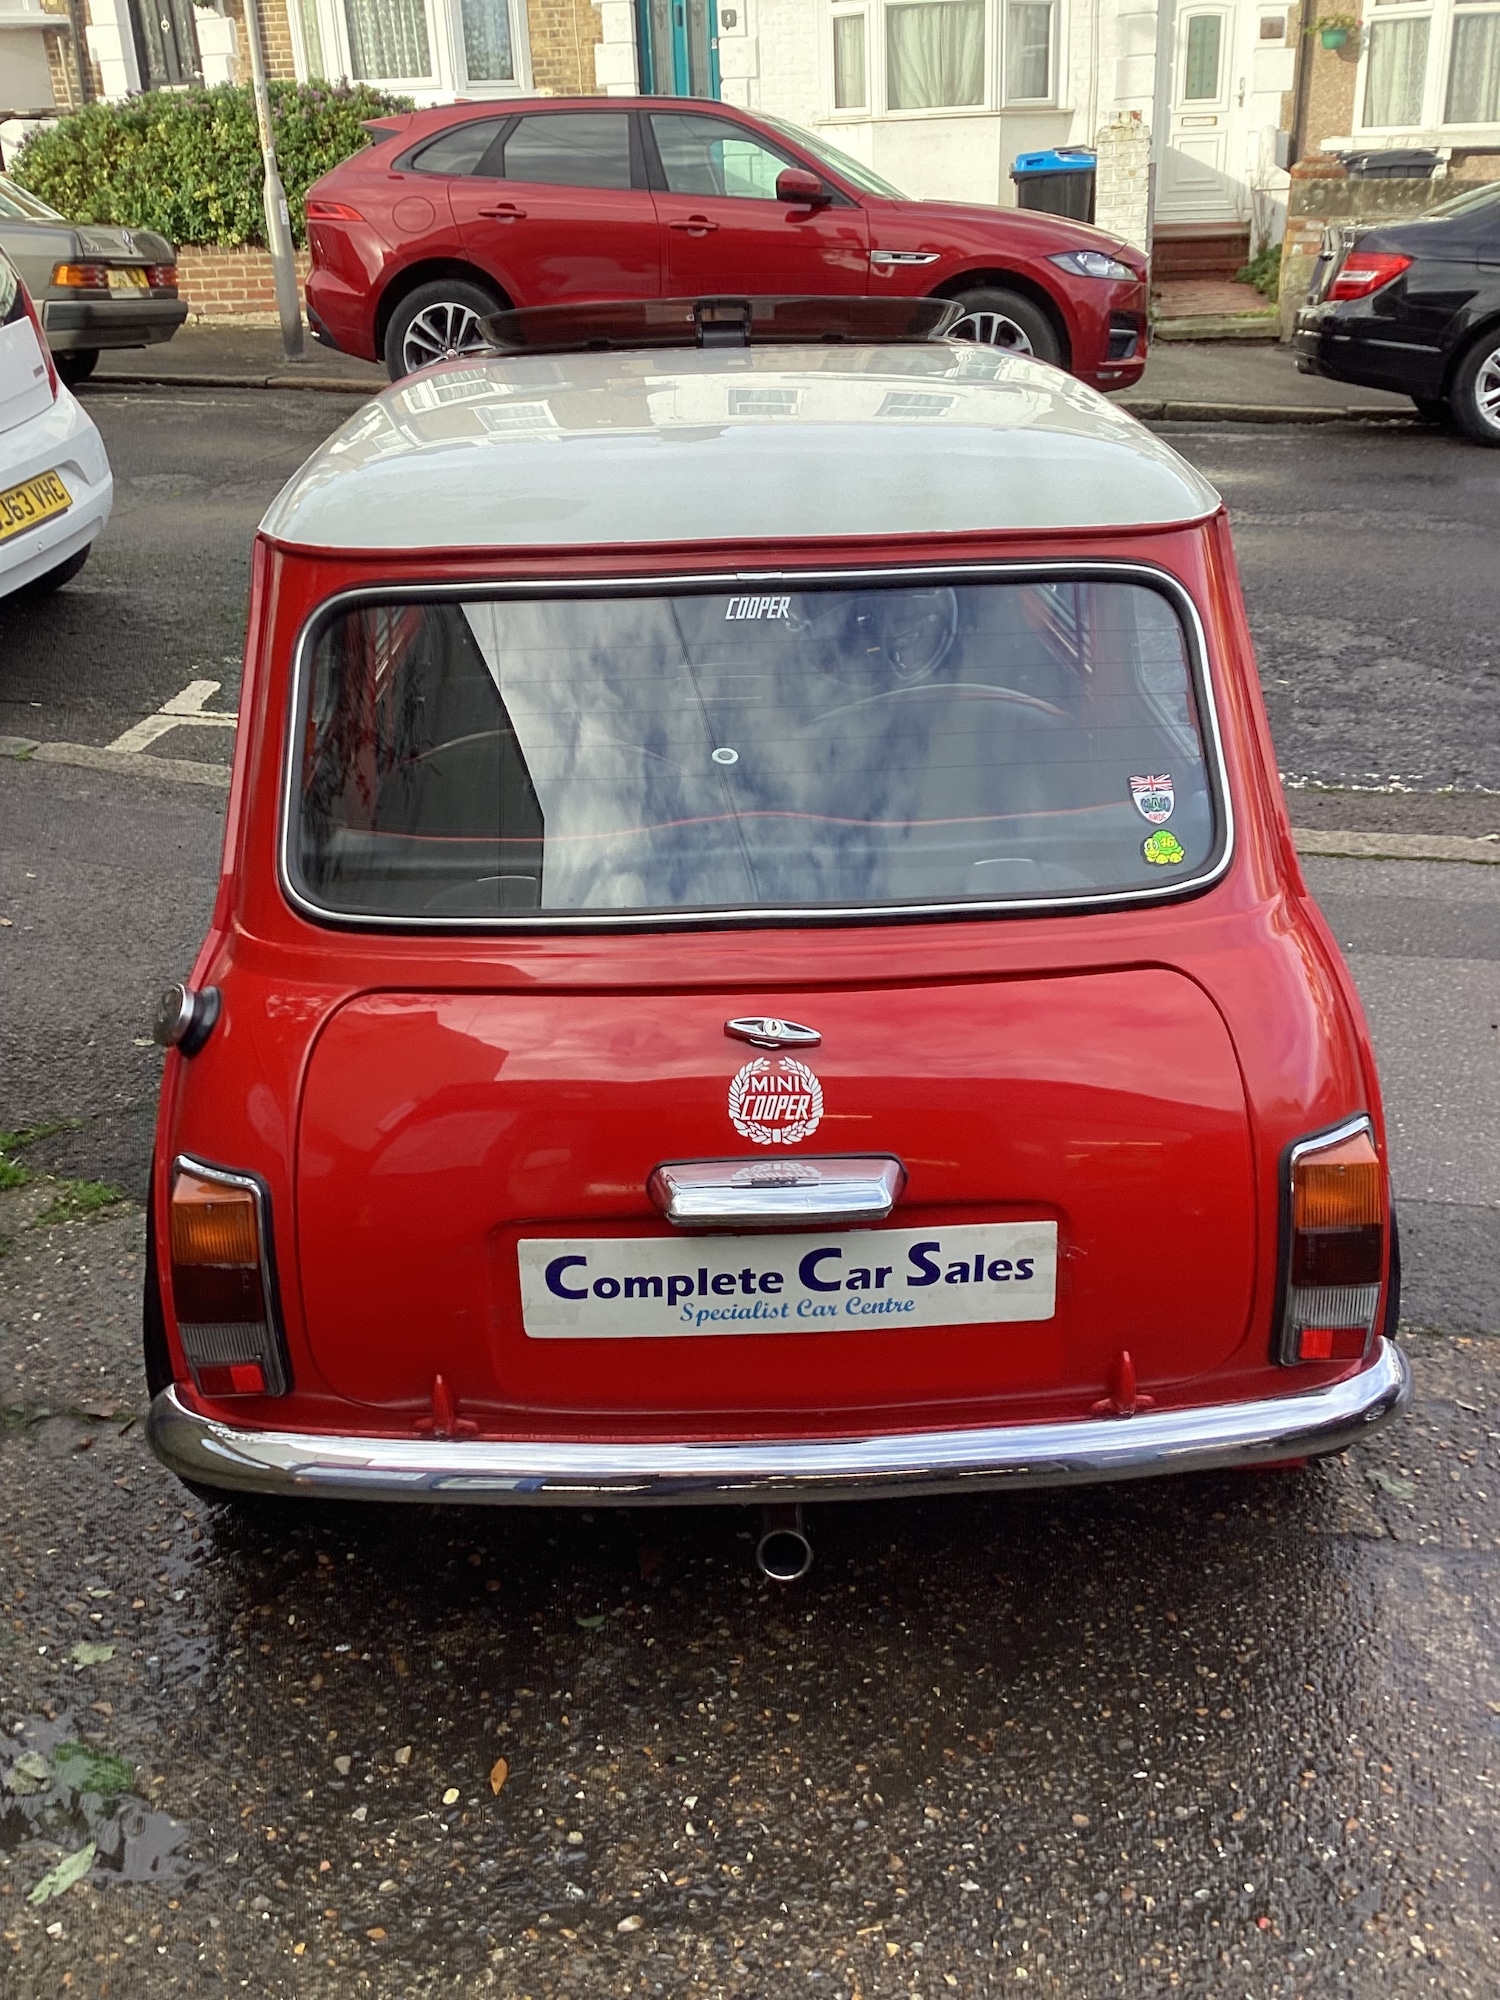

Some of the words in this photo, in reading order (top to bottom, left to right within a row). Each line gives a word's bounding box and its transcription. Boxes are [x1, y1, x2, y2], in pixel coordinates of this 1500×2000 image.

[0, 491, 36, 530] J63
[725, 596, 791, 620] COOPER
[1160, 837, 1175, 848] 46
[751, 1075, 800, 1092] MINI
[740, 1095, 811, 1120] COOPER
[545, 1255, 784, 1306] Complete
[798, 1247, 892, 1292] Car
[906, 1241, 1034, 1286] Sales
[680, 1300, 790, 1326] Specialist
[796, 1298, 839, 1318] Car
[845, 1296, 915, 1315] Centre
